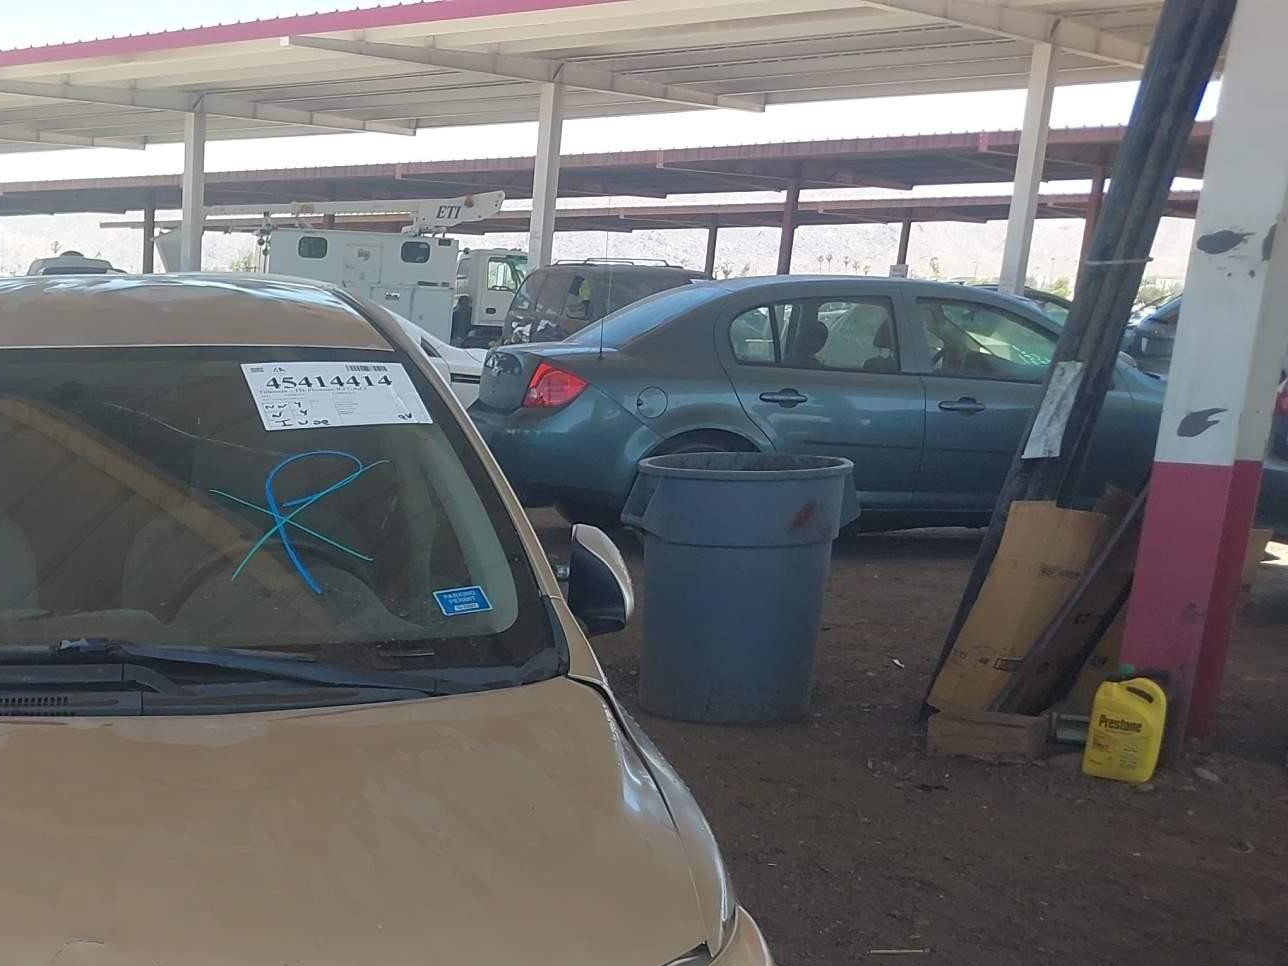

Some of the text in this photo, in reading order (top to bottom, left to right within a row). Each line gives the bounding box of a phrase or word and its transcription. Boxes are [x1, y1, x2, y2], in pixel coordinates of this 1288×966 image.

[436, 205, 462, 219] ETI
[266, 375, 393, 389] 45414414
[1098, 714, 1142, 732] Prestone
